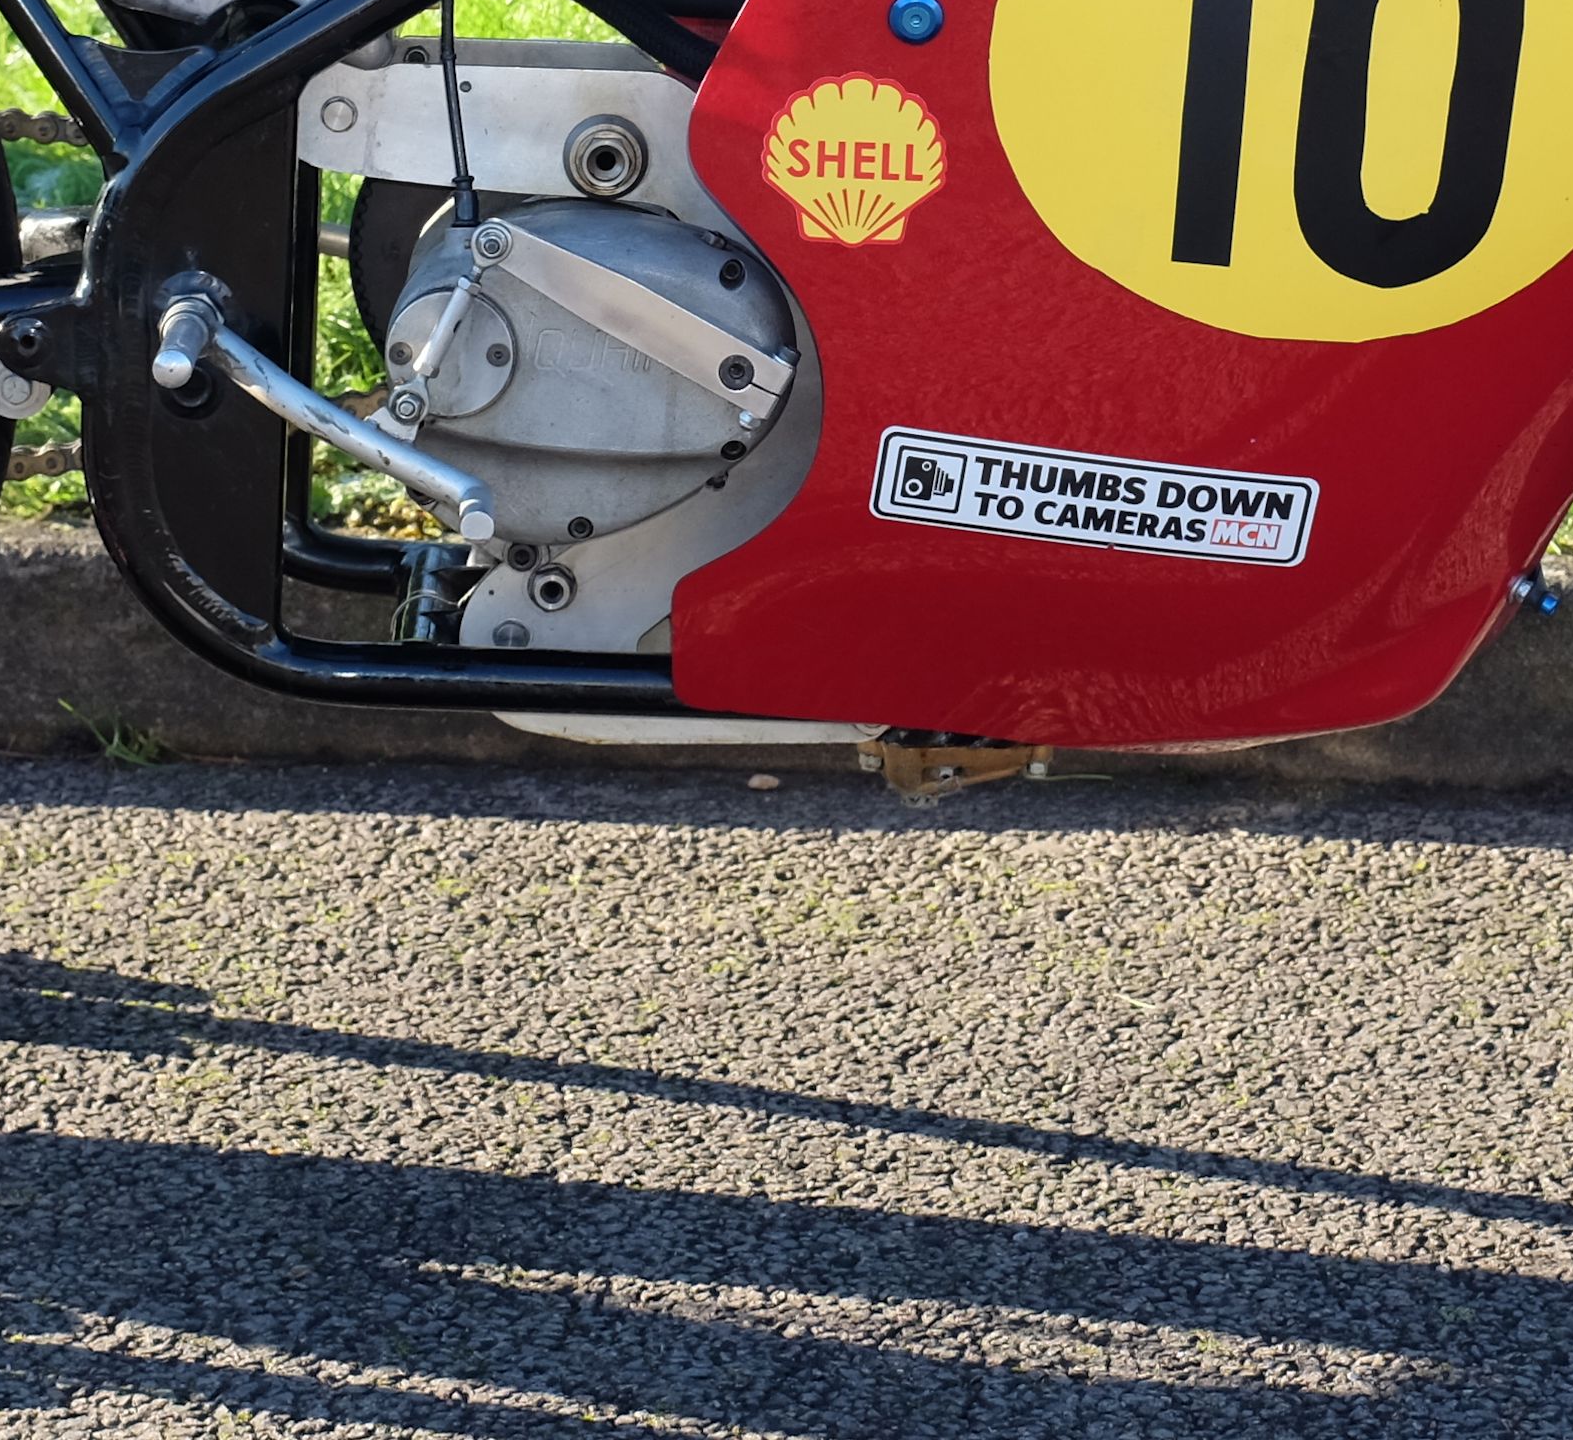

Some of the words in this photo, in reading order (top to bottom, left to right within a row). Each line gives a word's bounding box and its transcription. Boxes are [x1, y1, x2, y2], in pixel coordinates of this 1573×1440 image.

[786, 139, 924, 182] SHELL
[974, 456, 1148, 506] THUMBS
[1156, 480, 1295, 521] DOWN
[974, 491, 1024, 520] TO
[1033, 500, 1208, 543] CAMERAS
[1210, 522, 1281, 549] MCN
